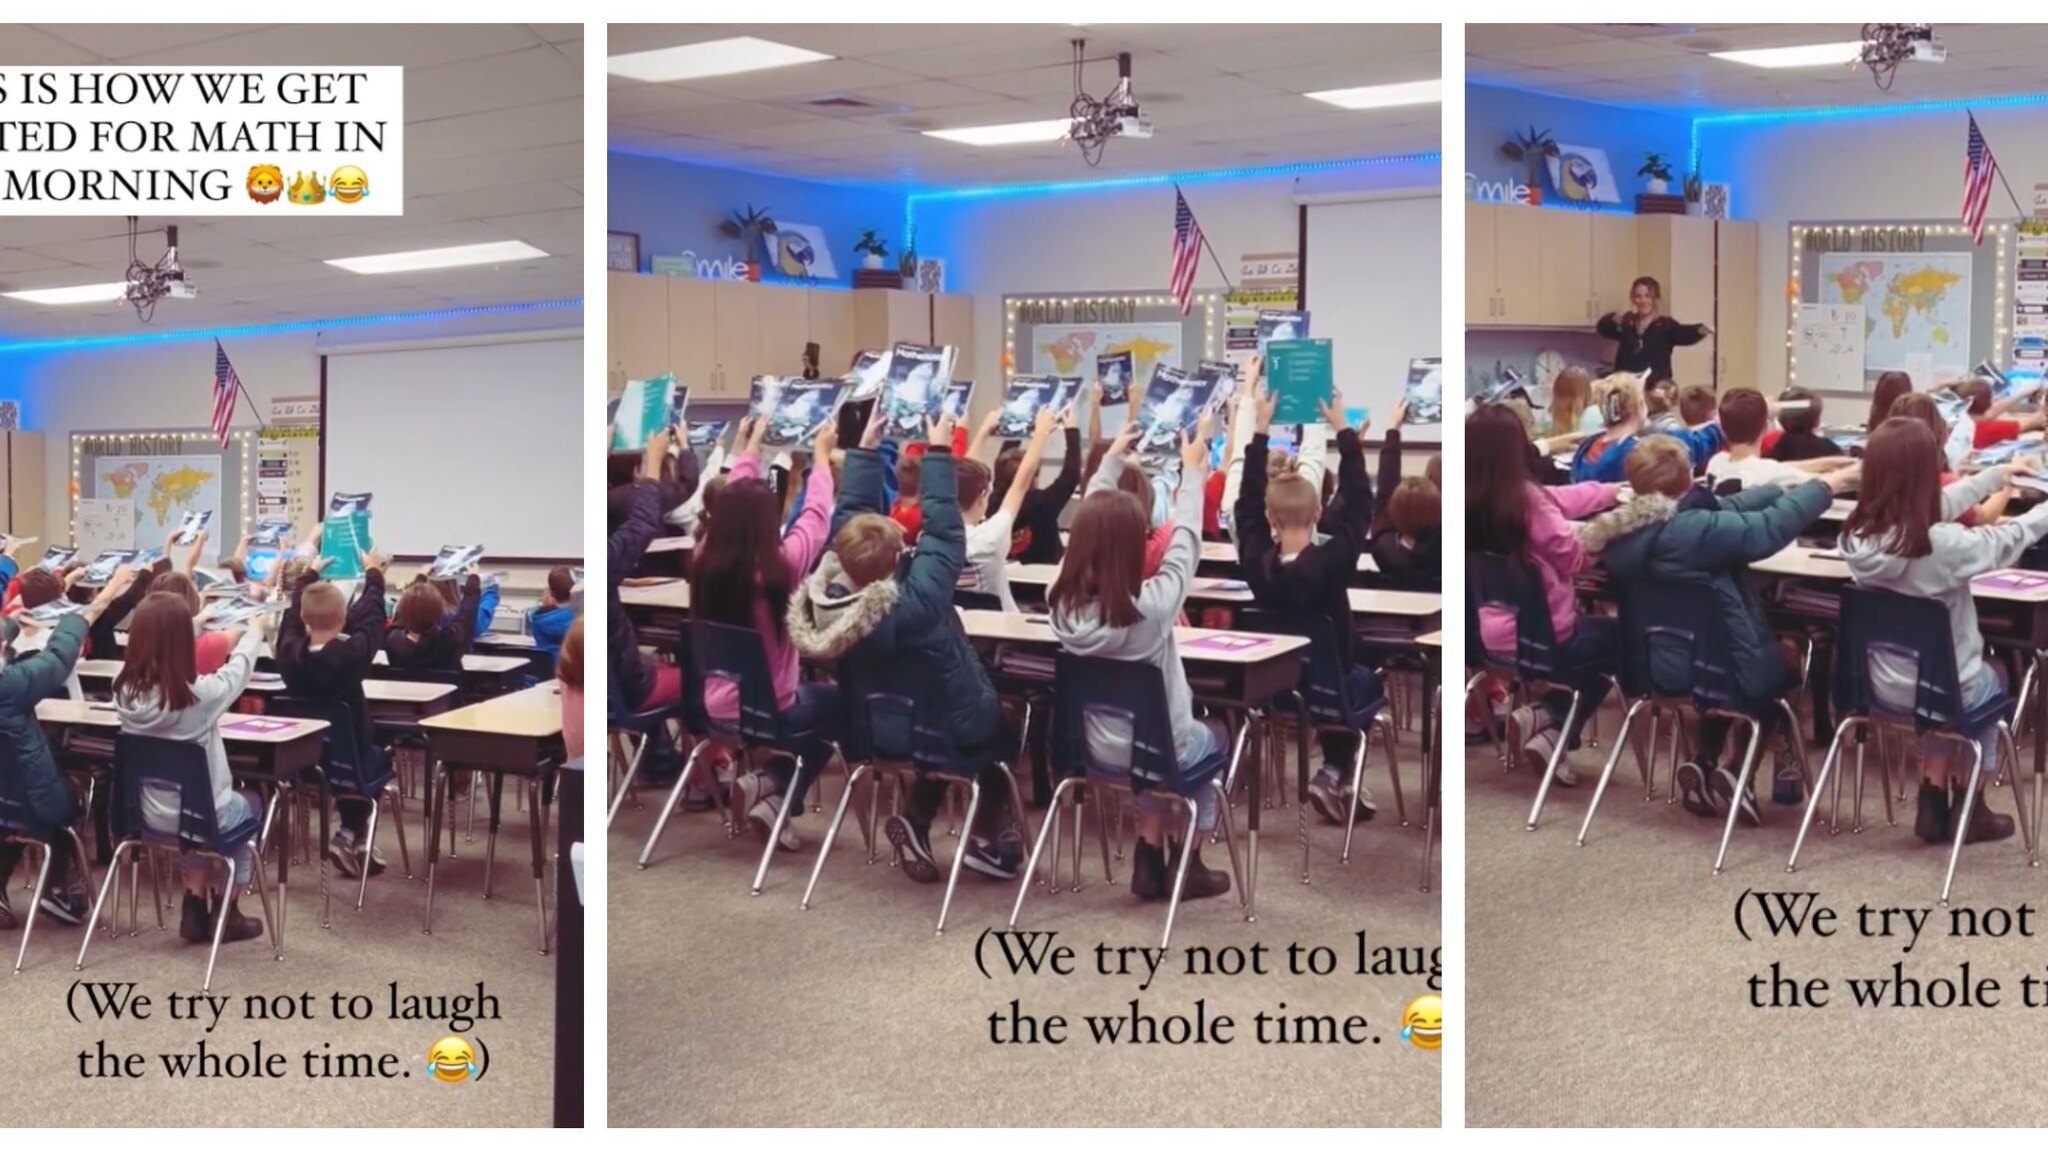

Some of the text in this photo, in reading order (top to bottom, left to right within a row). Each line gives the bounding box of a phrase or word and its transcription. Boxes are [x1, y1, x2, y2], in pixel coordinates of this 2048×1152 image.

[1806, 228, 1926, 252] WORLD HISTORY
[1018, 301, 1136, 324] WORLD HISTORY
[83, 435, 183, 456] WORLD HISTORY
